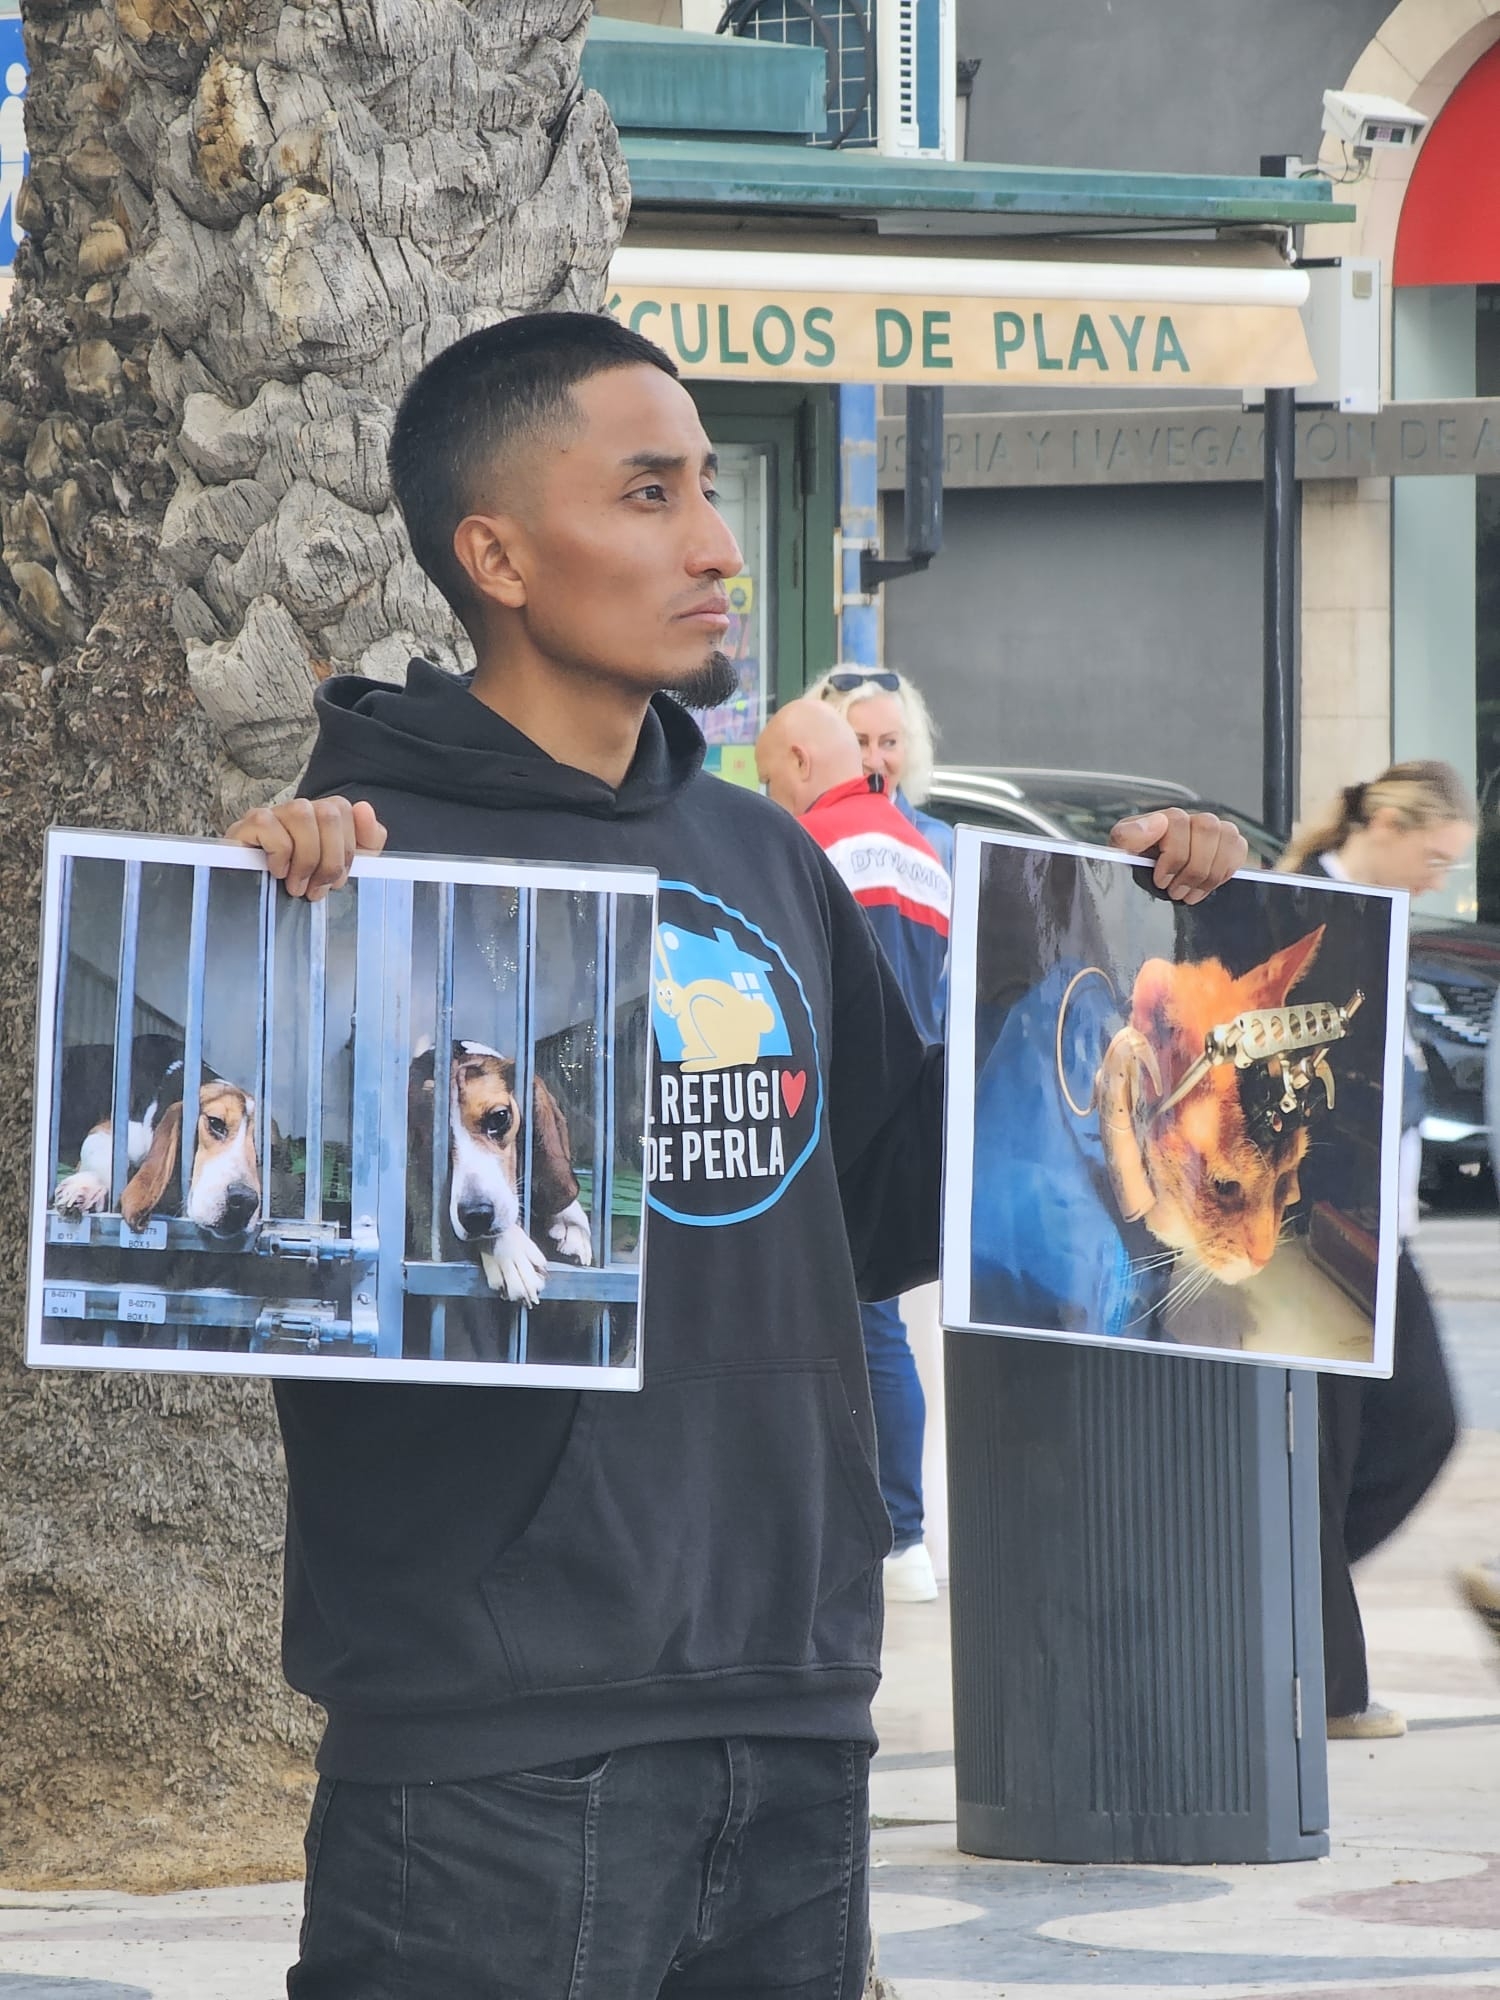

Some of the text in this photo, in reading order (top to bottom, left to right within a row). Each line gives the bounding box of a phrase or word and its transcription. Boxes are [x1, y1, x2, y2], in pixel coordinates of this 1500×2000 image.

[875, 308, 953, 370] DE
[994, 311, 1191, 373] PLAYA
[1027, 430, 1051, 471] Y
[1400, 418, 1457, 460] DE
[647, 1126, 785, 1182] DE PERLA
